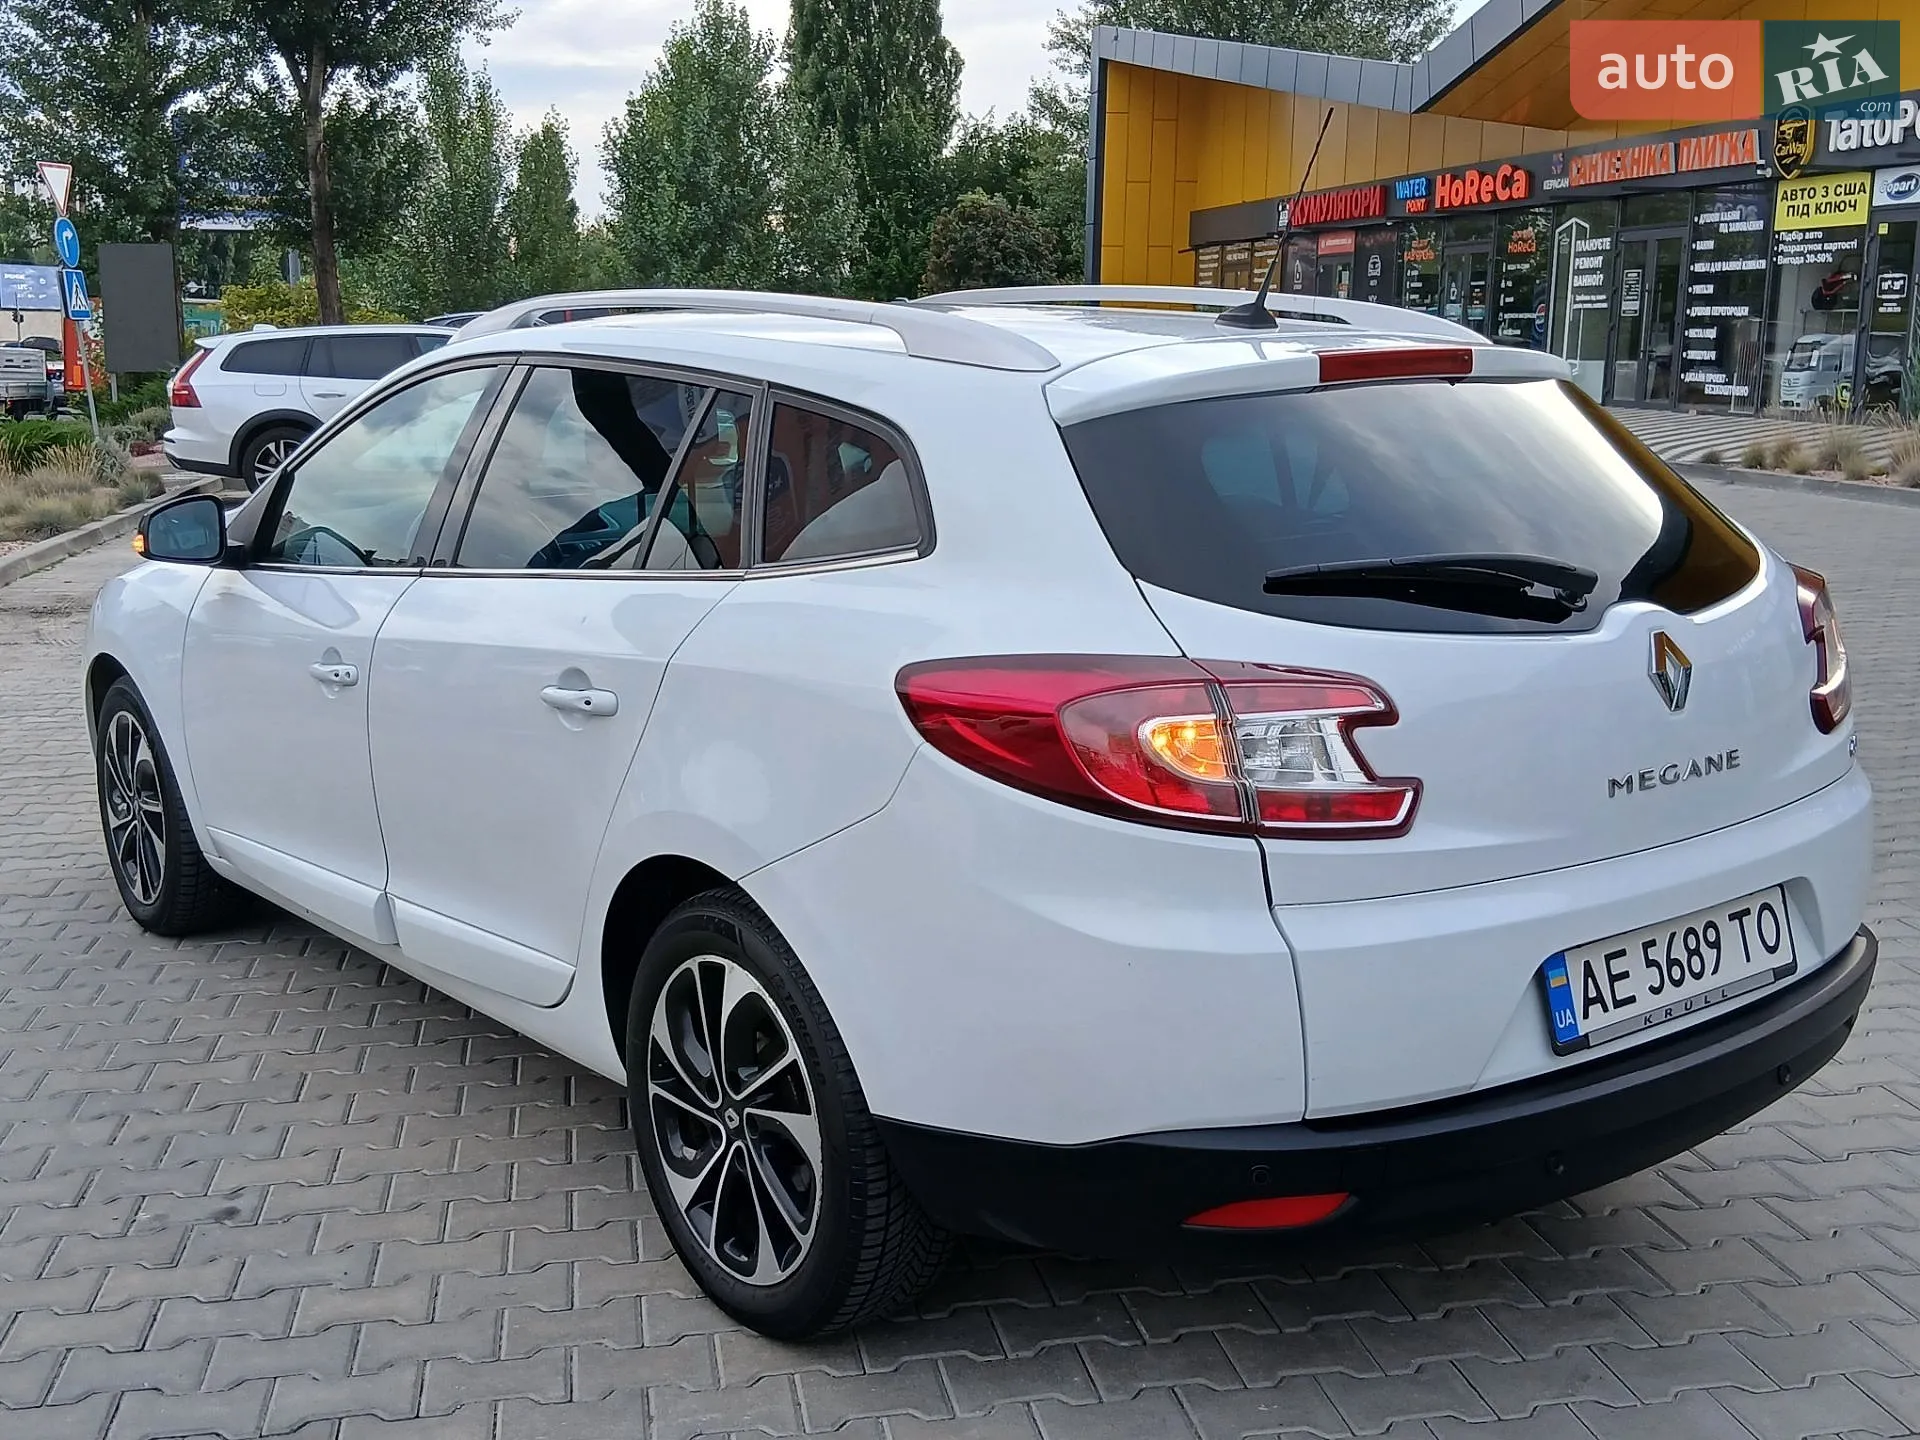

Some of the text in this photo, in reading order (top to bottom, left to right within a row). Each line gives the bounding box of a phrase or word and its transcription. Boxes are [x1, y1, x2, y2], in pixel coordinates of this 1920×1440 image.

[1825, 99, 1920, 153] TatoP
[1569, 142, 1676, 187] САНТЕХНІКА
[1678, 128, 1759, 172] ПЛИТКА
[1775, 143, 1807, 156] CarWay
[1395, 177, 1427, 199] WATER
[1435, 163, 1528, 209] HoReCa
[1780, 187, 1817, 202] АВТО
[1833, 182, 1867, 197] США
[1406, 198, 1427, 213] POINT
[1786, 199, 1858, 219] ПІД КЛЮЧ
[1804, 231, 1823, 240] авто
[1607, 749, 1741, 799] MEGANE
[1581, 901, 1782, 1021] AE 5689 TO
[1554, 1009, 1576, 1029] UA
